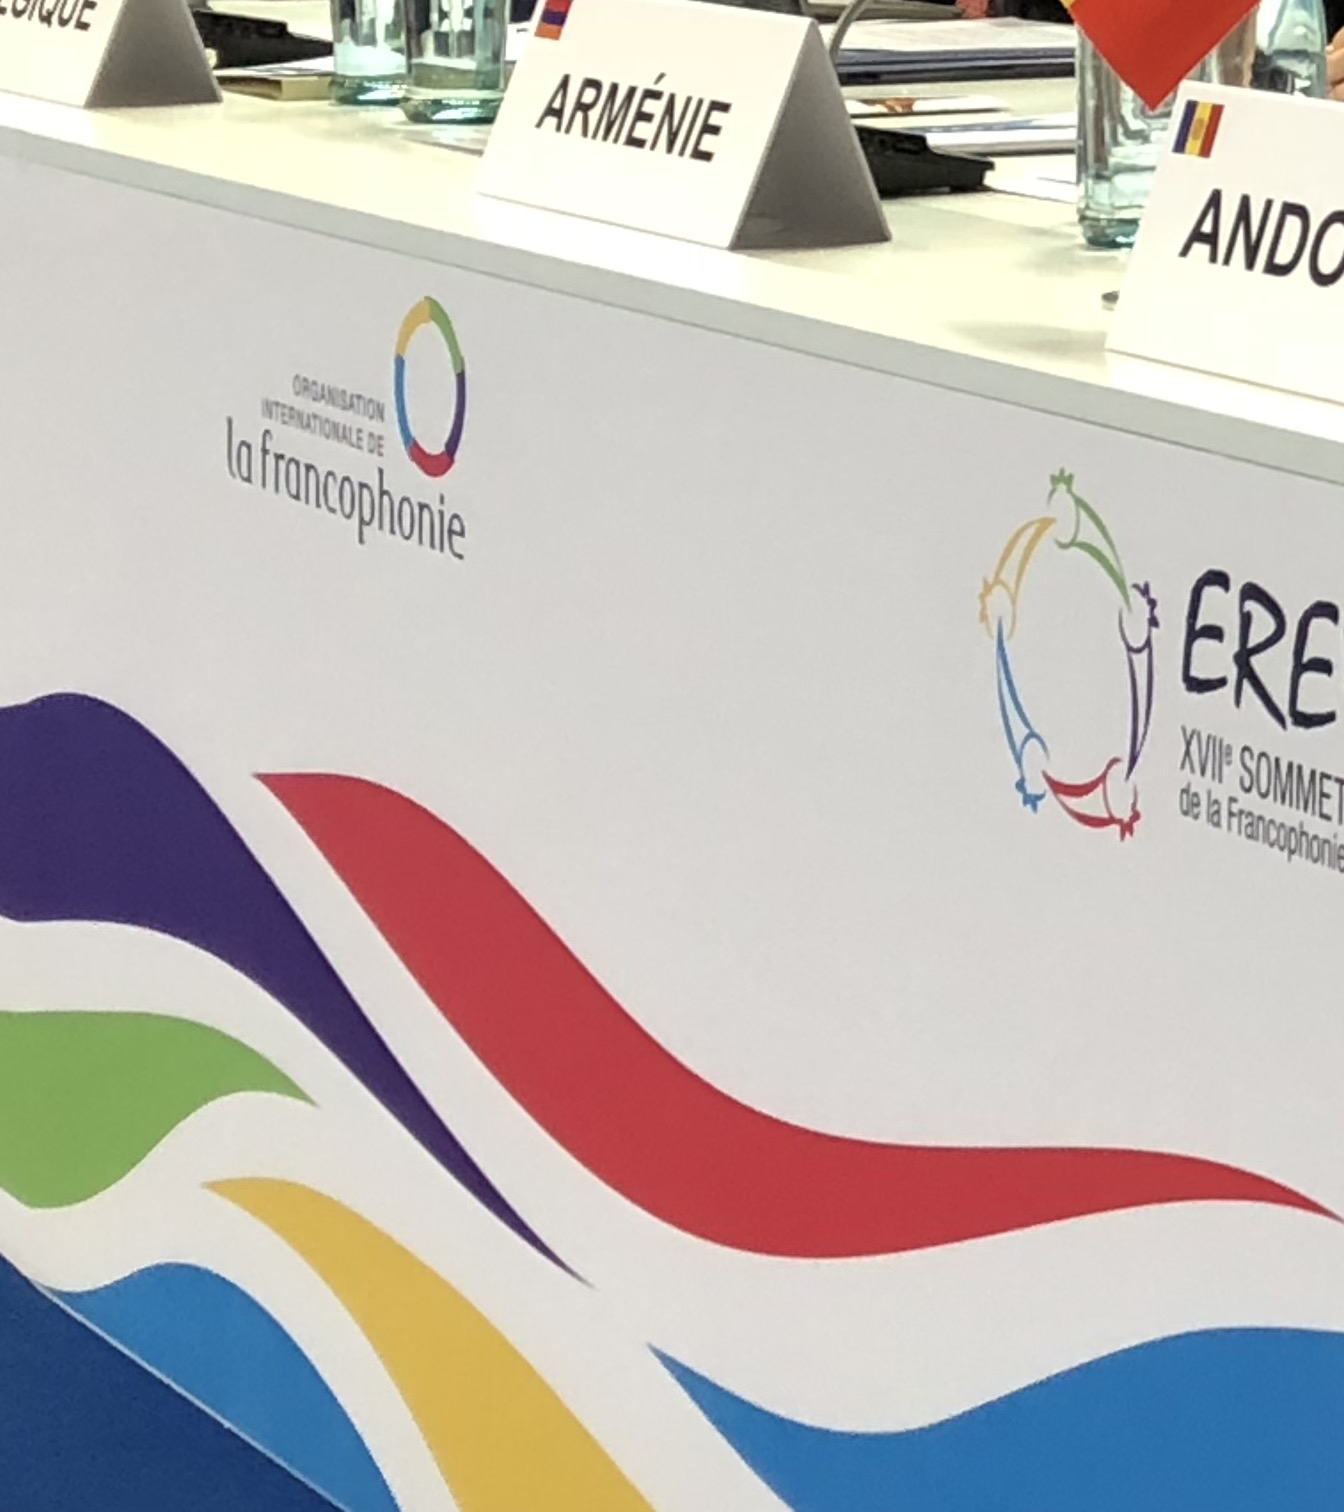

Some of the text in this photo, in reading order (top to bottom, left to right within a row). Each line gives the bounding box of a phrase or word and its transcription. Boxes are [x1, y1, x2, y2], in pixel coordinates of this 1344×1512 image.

[535, 72, 732, 163] ARMÉNIE
[260, 396, 385, 457] INTERNATIONALE DE
[291, 373, 386, 423] ORGANISATION
[226, 415, 467, 561] la francophonie
[1178, 782, 1202, 821] de
[1206, 788, 1222, 829] la
